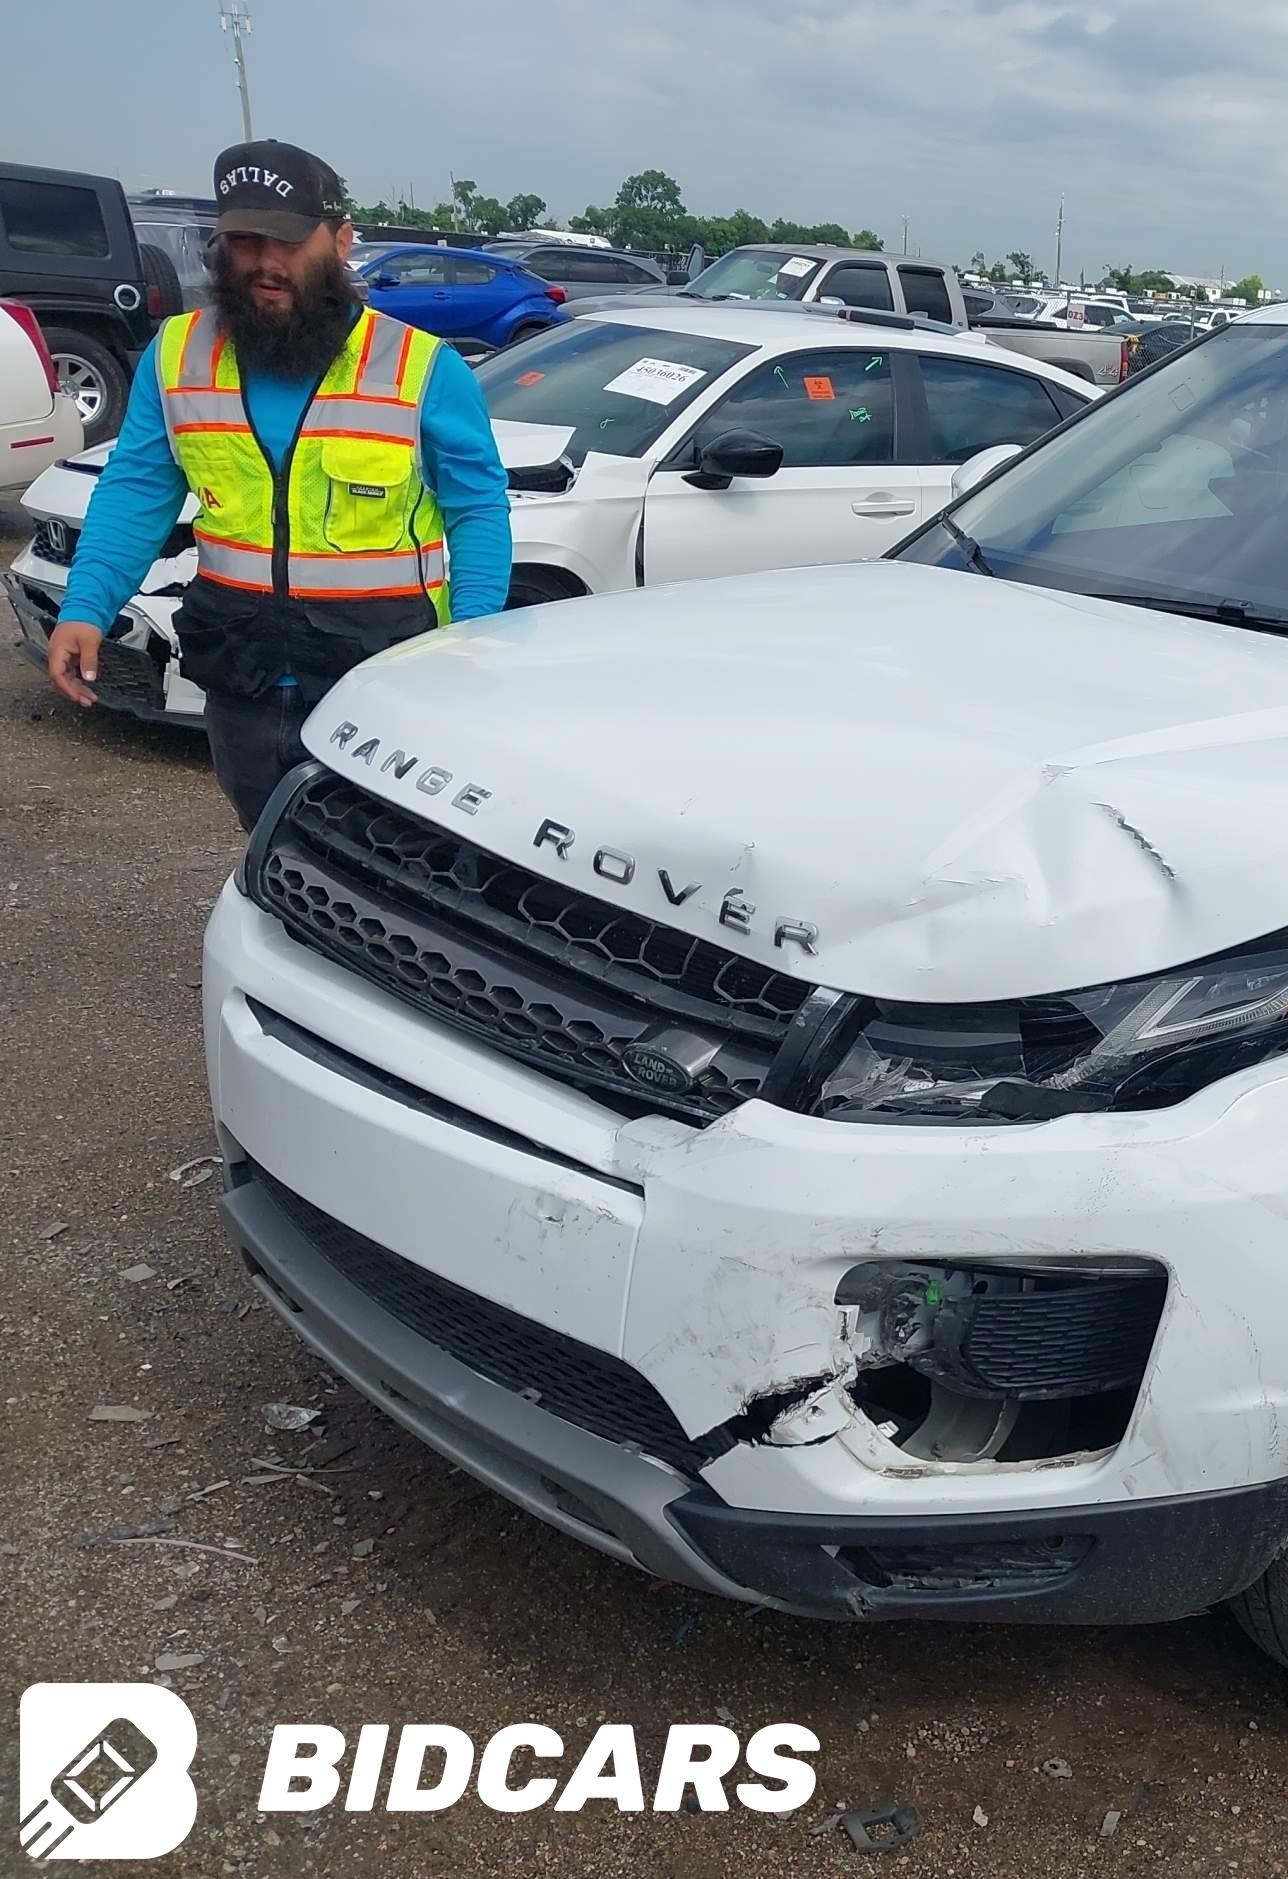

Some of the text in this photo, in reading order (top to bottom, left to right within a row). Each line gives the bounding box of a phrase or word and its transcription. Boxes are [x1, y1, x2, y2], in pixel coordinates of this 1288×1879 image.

[219, 166, 294, 198] DALLAS
[329, 720, 820, 957] RANGE ROVER
[633, 1053, 666, 1074] LAND
[637, 1066, 678, 1086] ROVER
